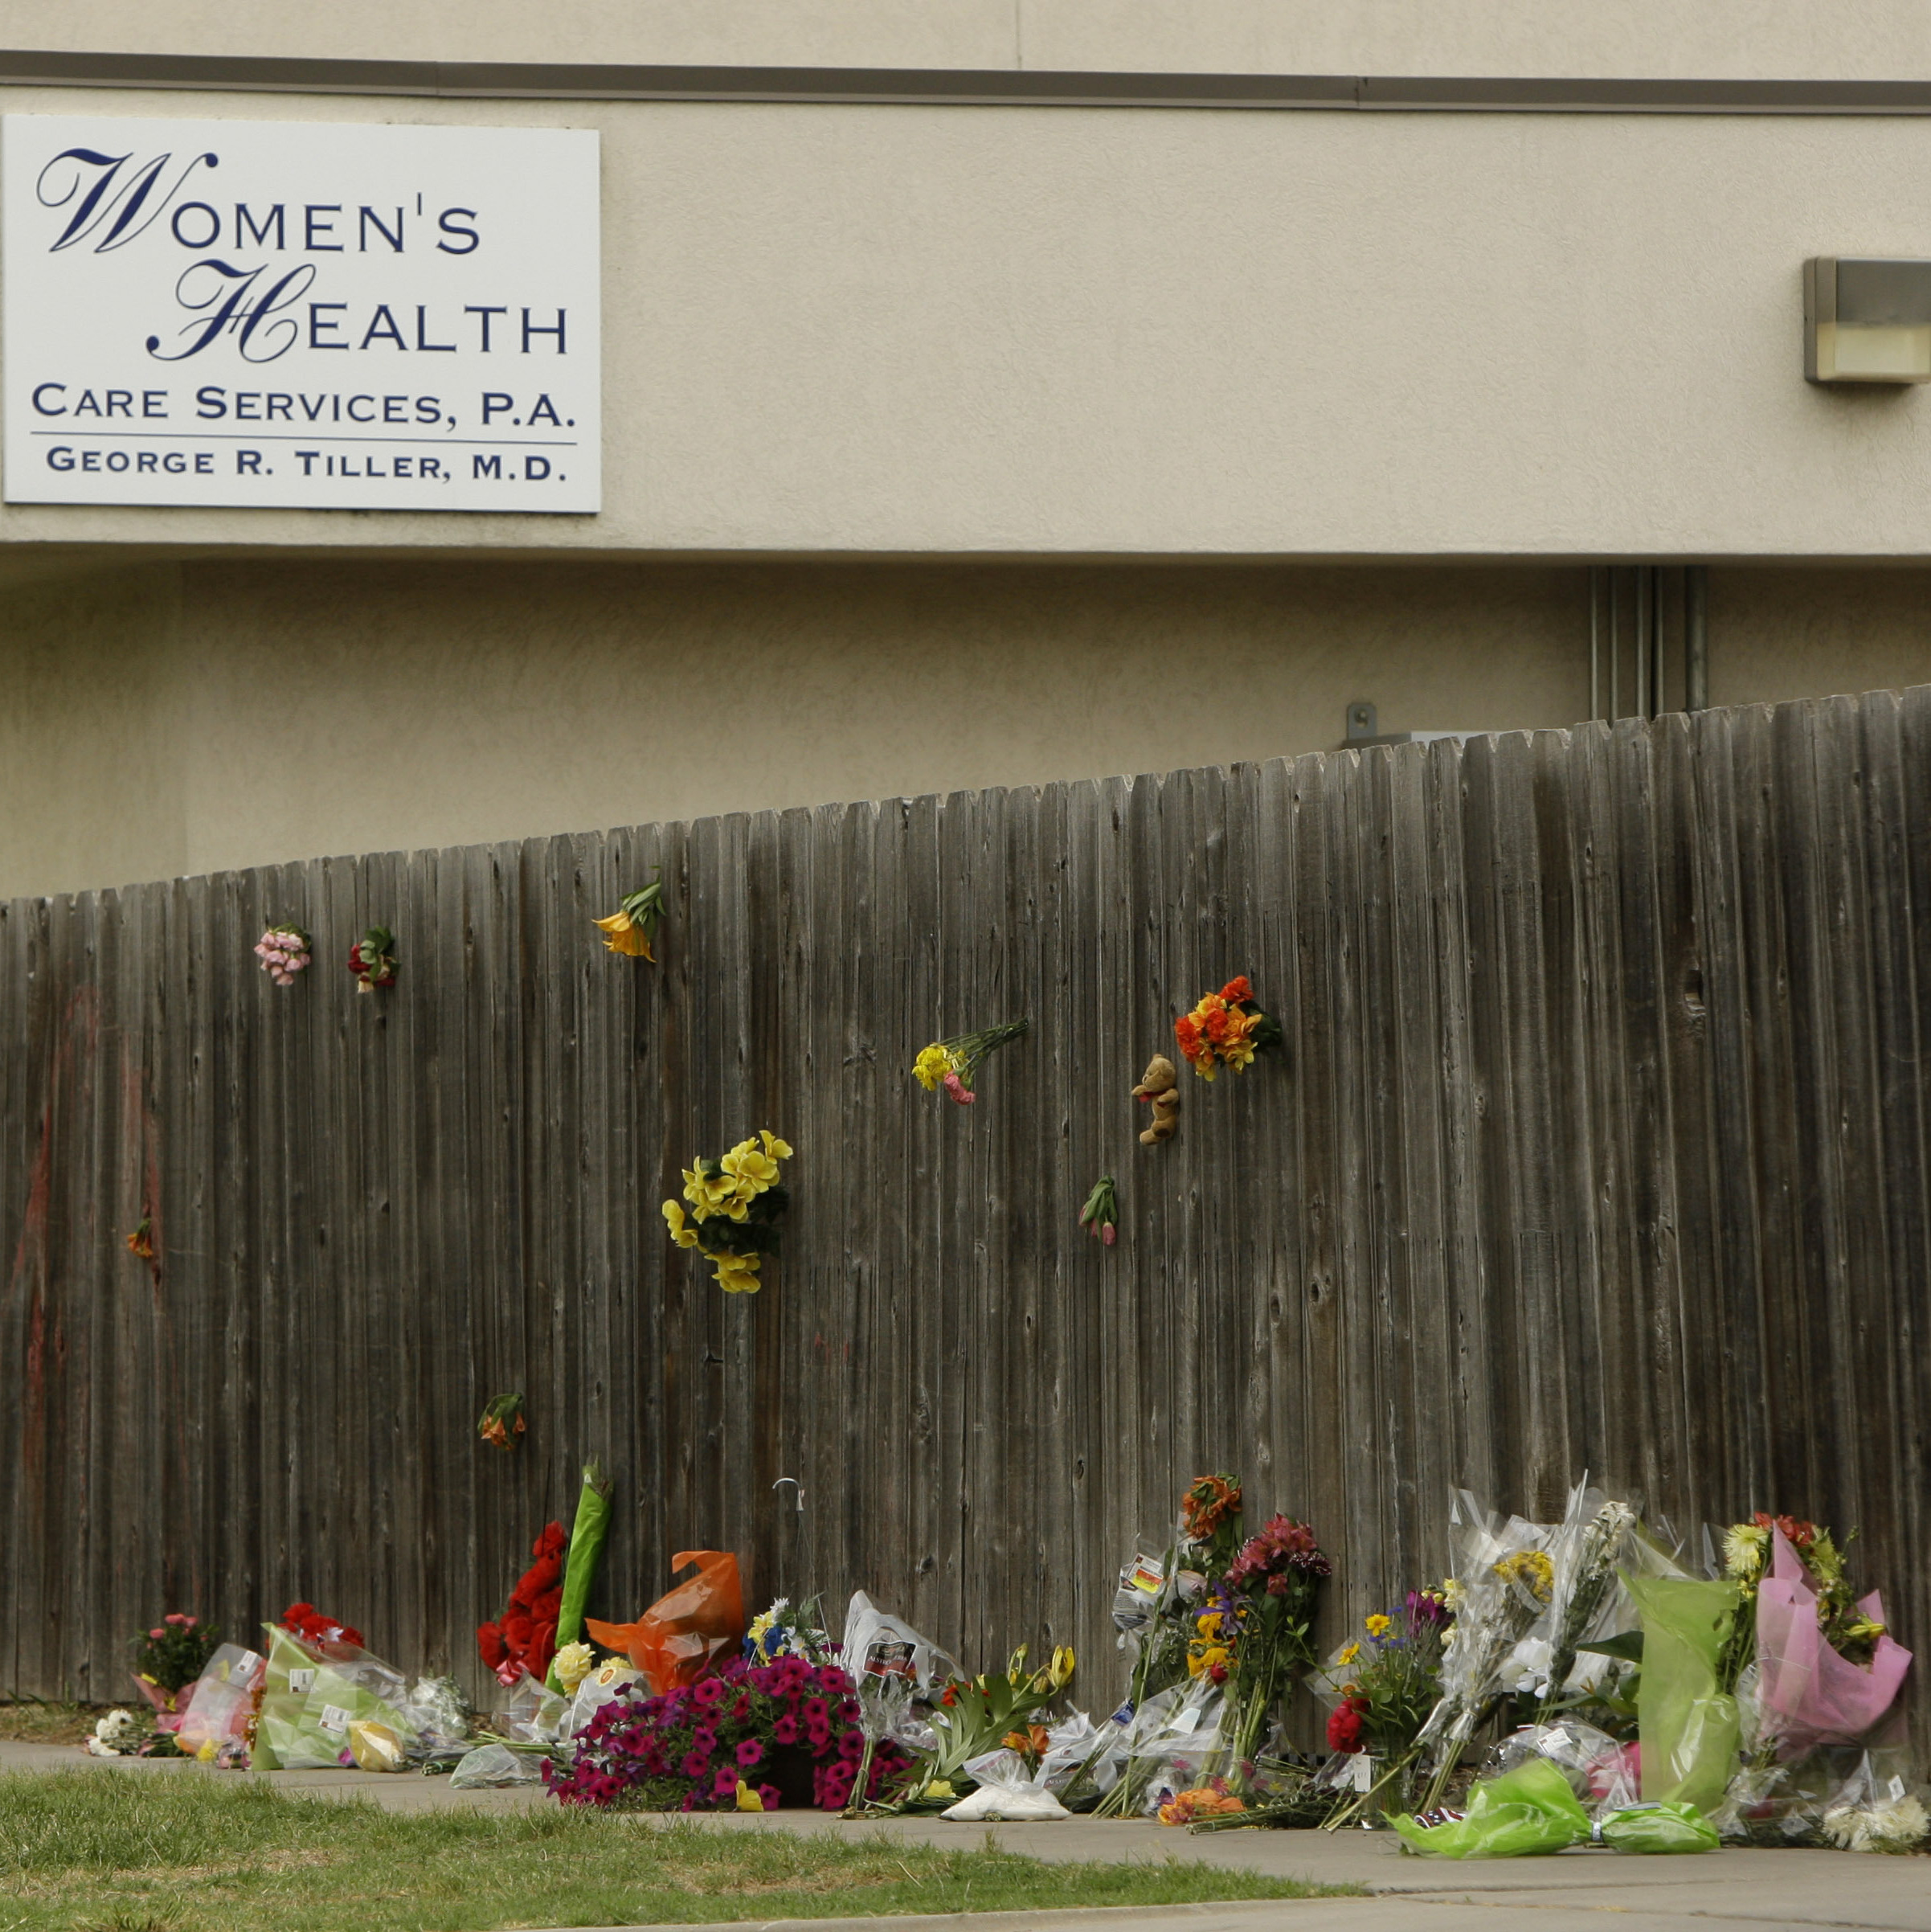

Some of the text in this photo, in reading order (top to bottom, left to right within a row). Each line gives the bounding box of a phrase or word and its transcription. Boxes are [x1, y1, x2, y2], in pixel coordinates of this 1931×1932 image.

[36, 147, 481, 256] WOMEN'S
[145, 258, 567, 364] HEALTH
[31, 382, 575, 432] CARE SERVICES, P.A.
[46, 445, 567, 483] GEORGE R. TILLER, M.D.
